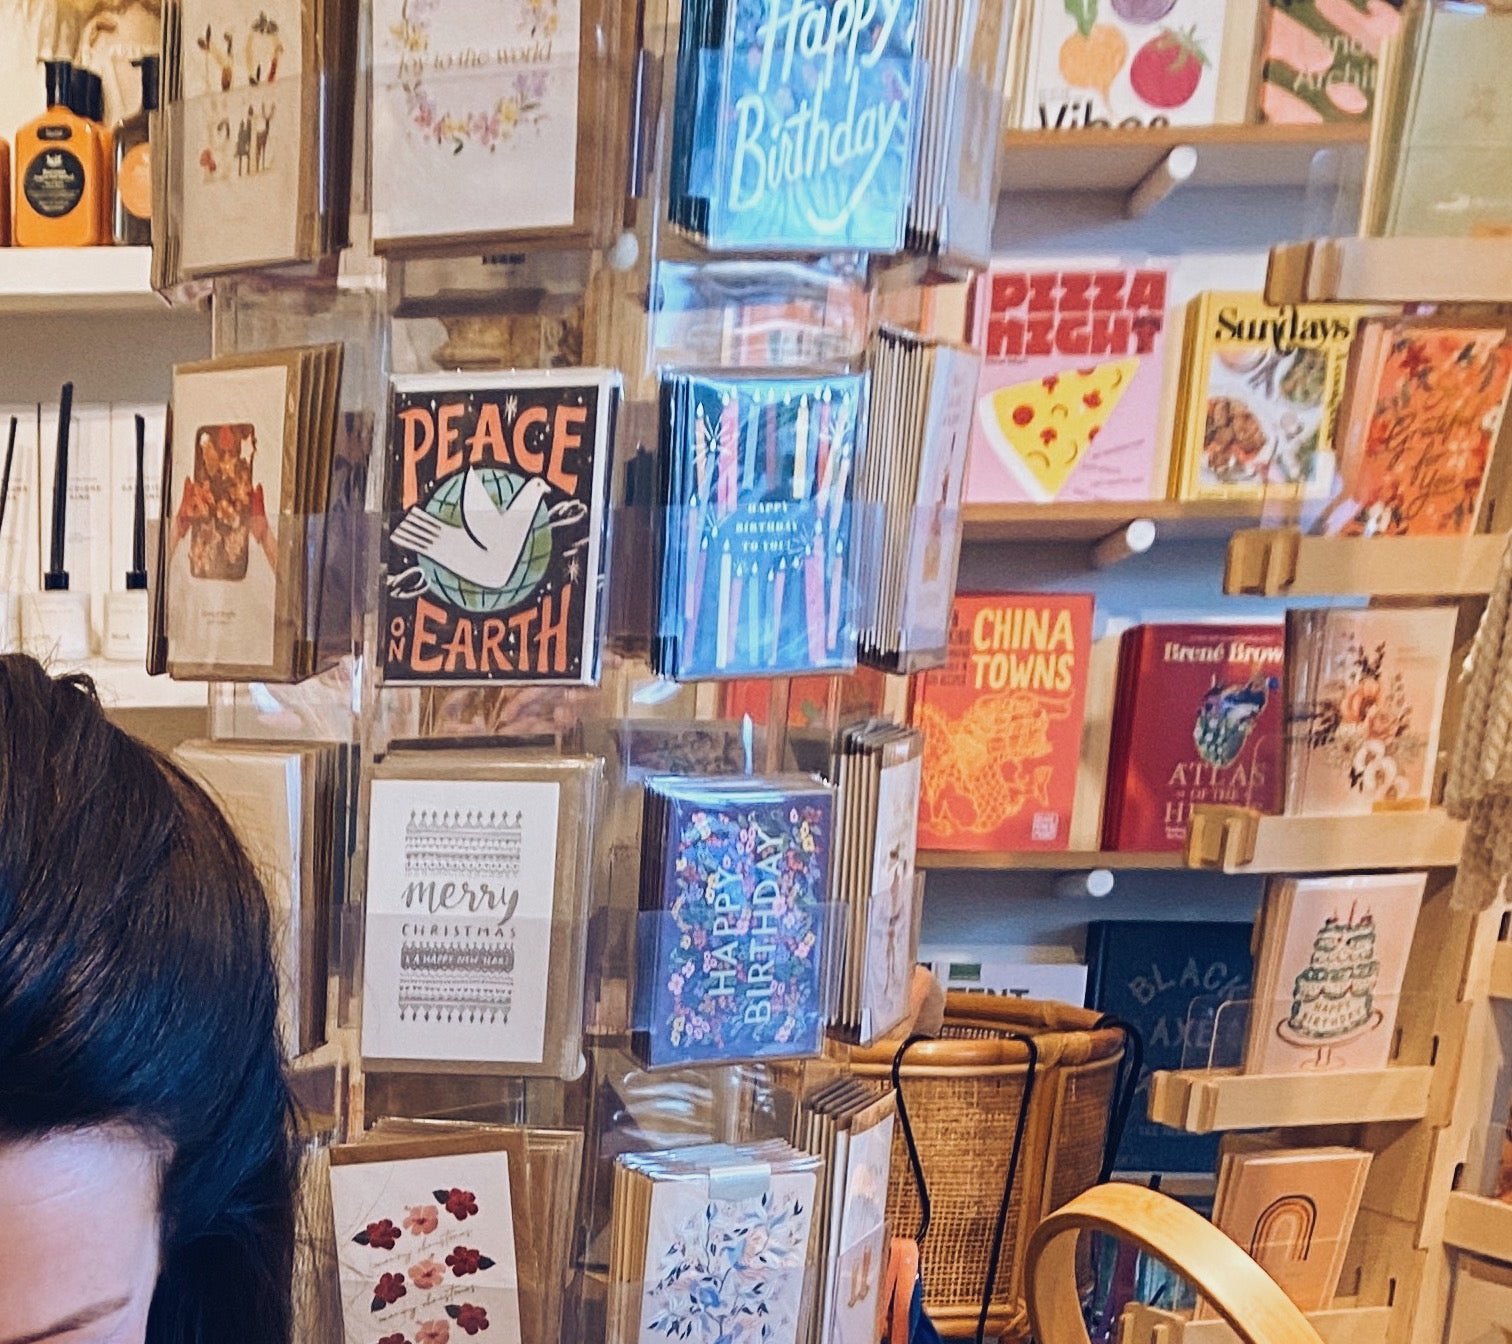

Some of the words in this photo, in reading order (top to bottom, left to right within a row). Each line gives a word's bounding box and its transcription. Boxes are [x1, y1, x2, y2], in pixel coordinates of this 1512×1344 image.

[757, 0, 900, 92] Happy
[728, 67, 901, 233] Birthday
[990, 272, 1167, 312] PIZZA
[986, 317, 1162, 355] NIGHT
[1215, 304, 1350, 354] Sundays
[398, 403, 588, 511] PEACE
[389, 616, 406, 662] ON
[410, 583, 571, 672] EARTH
[973, 607, 1074, 651] CHINA
[972, 653, 1075, 691] TOWNS
[1164, 641, 1224, 662] Brené
[1229, 642, 1283, 663] Brow
[401, 881, 519, 926] merry
[744, 828, 786, 1024] BIRTHDAY
[402, 923, 516, 937] CHRISTMAS
[708, 866, 743, 996] HAPPY
[1129, 957, 1249, 1004] BLACK
